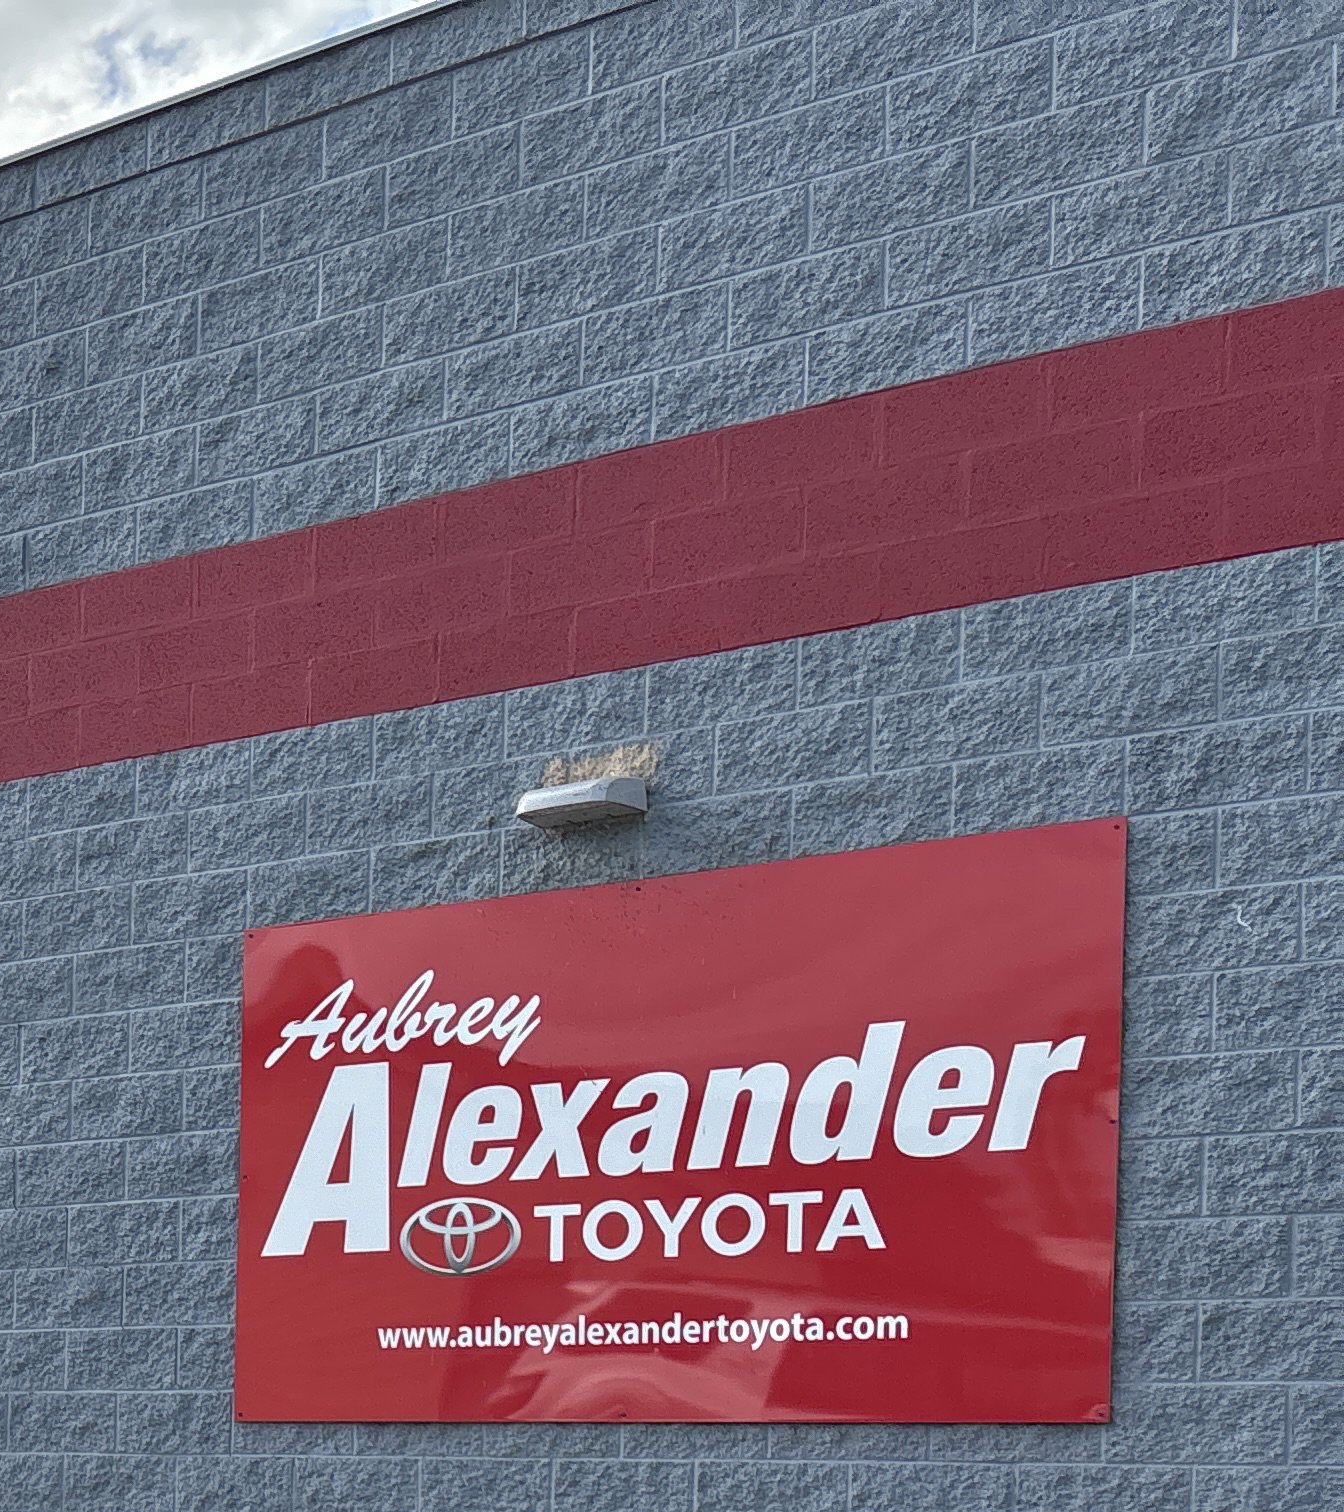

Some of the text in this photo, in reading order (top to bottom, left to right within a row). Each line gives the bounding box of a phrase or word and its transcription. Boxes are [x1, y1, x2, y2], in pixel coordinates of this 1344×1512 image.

[264, 970, 541, 1067] Aubrey
[261, 1020, 1086, 1257] Alexander
[534, 1188, 886, 1263] TOYOTA
[377, 1309, 910, 1353] www.aubreyalexandertoyota.com
